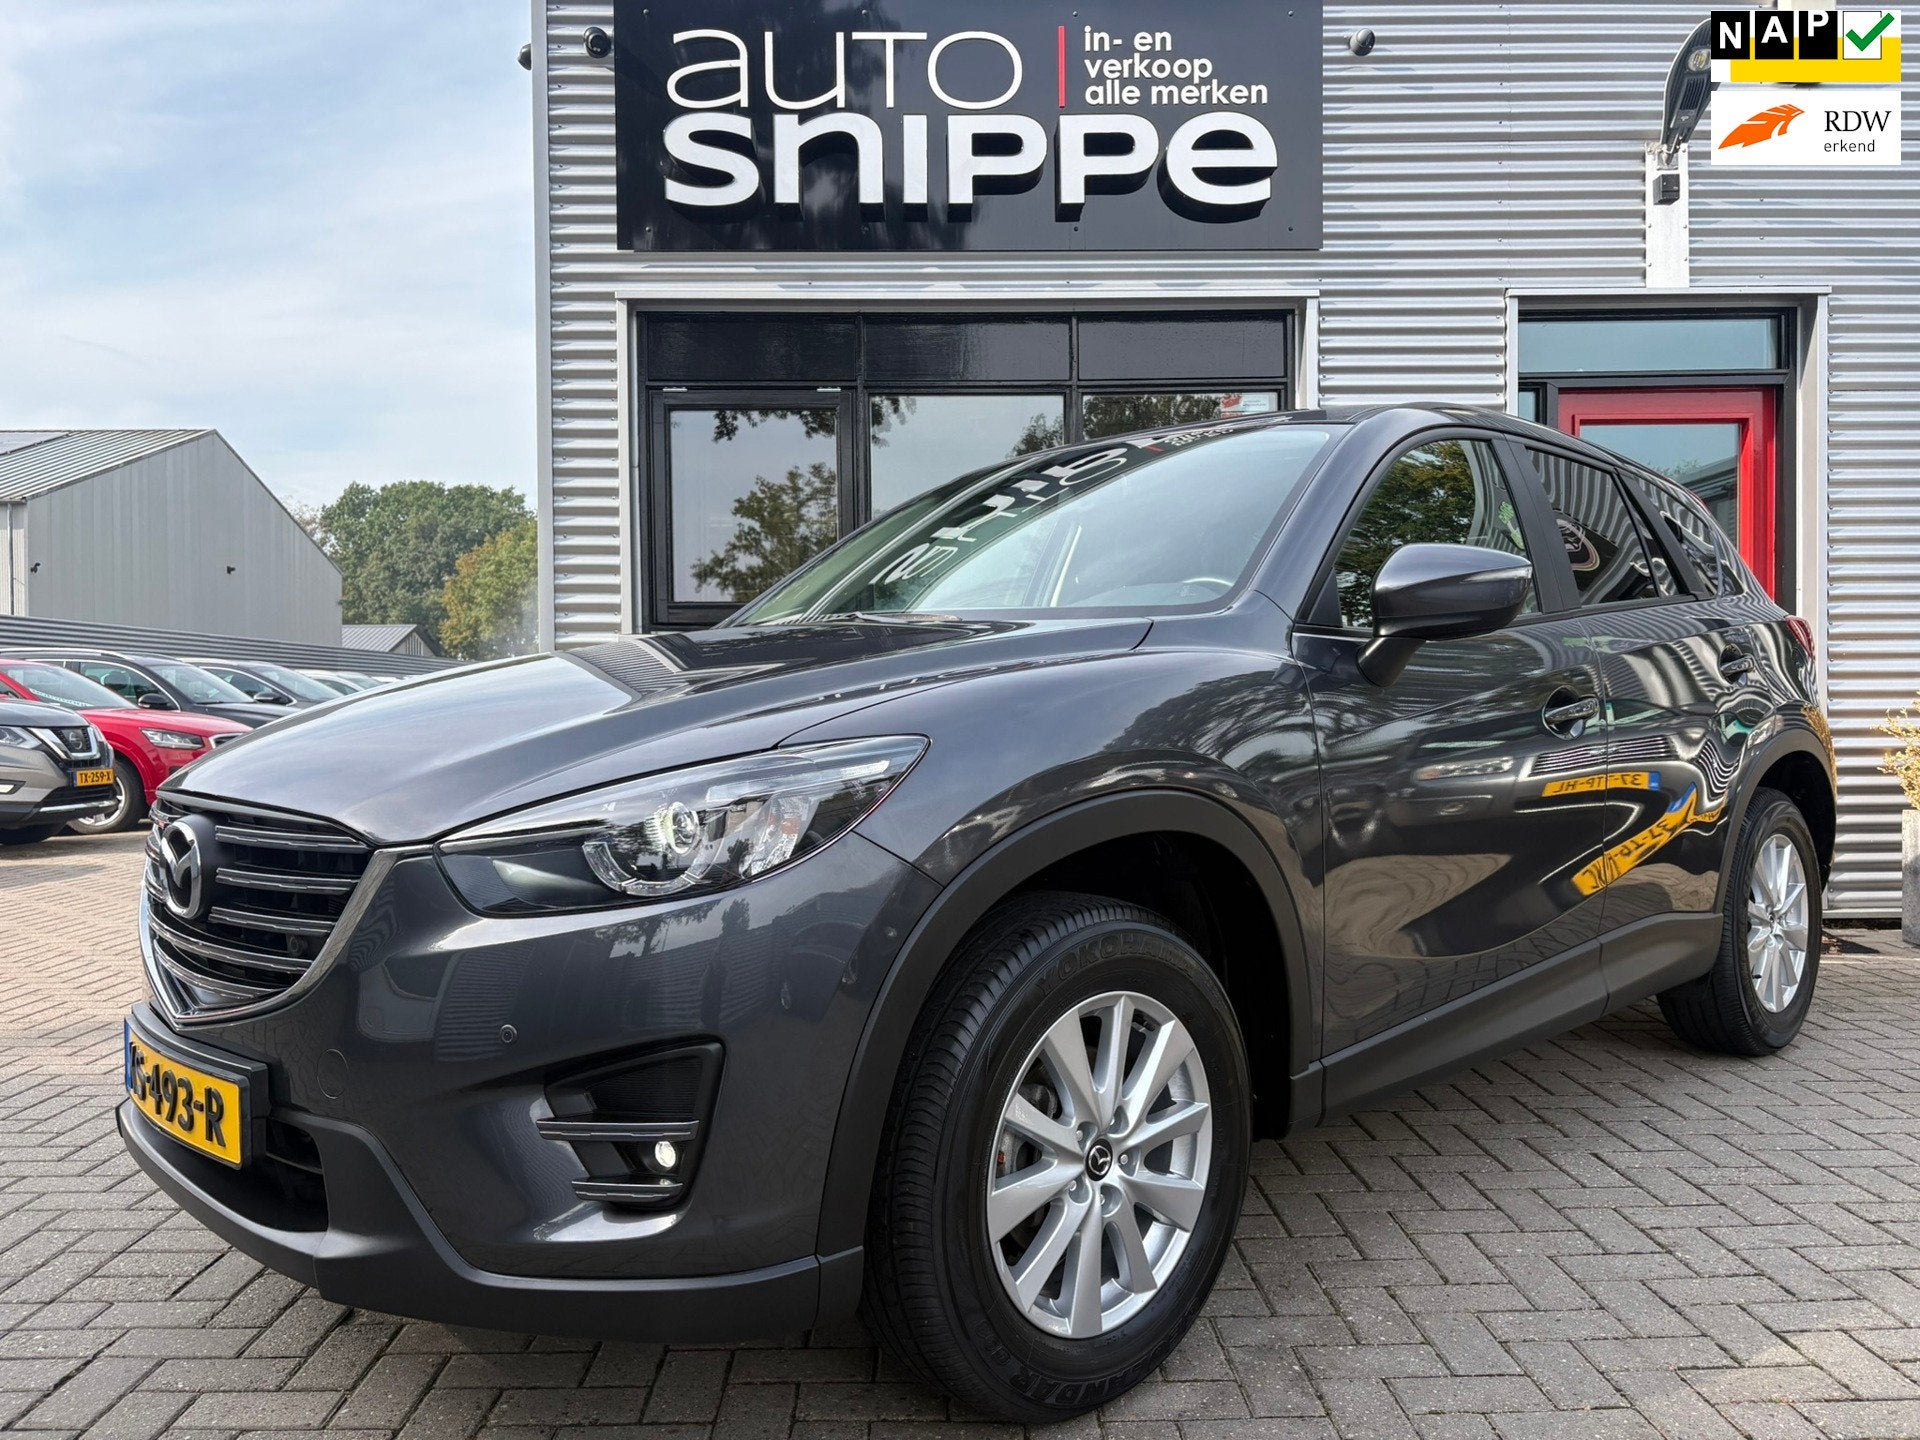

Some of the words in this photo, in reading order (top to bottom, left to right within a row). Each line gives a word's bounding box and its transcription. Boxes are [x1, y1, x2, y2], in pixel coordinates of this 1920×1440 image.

[1084, 25, 1122, 52] in-
[1133, 30, 1172, 52] en
[1084, 54, 1213, 84] verkoop
[1084, 79, 1143, 106] alle
[1151, 80, 1268, 105] merken
[79, 771, 112, 784] TX-259-X
